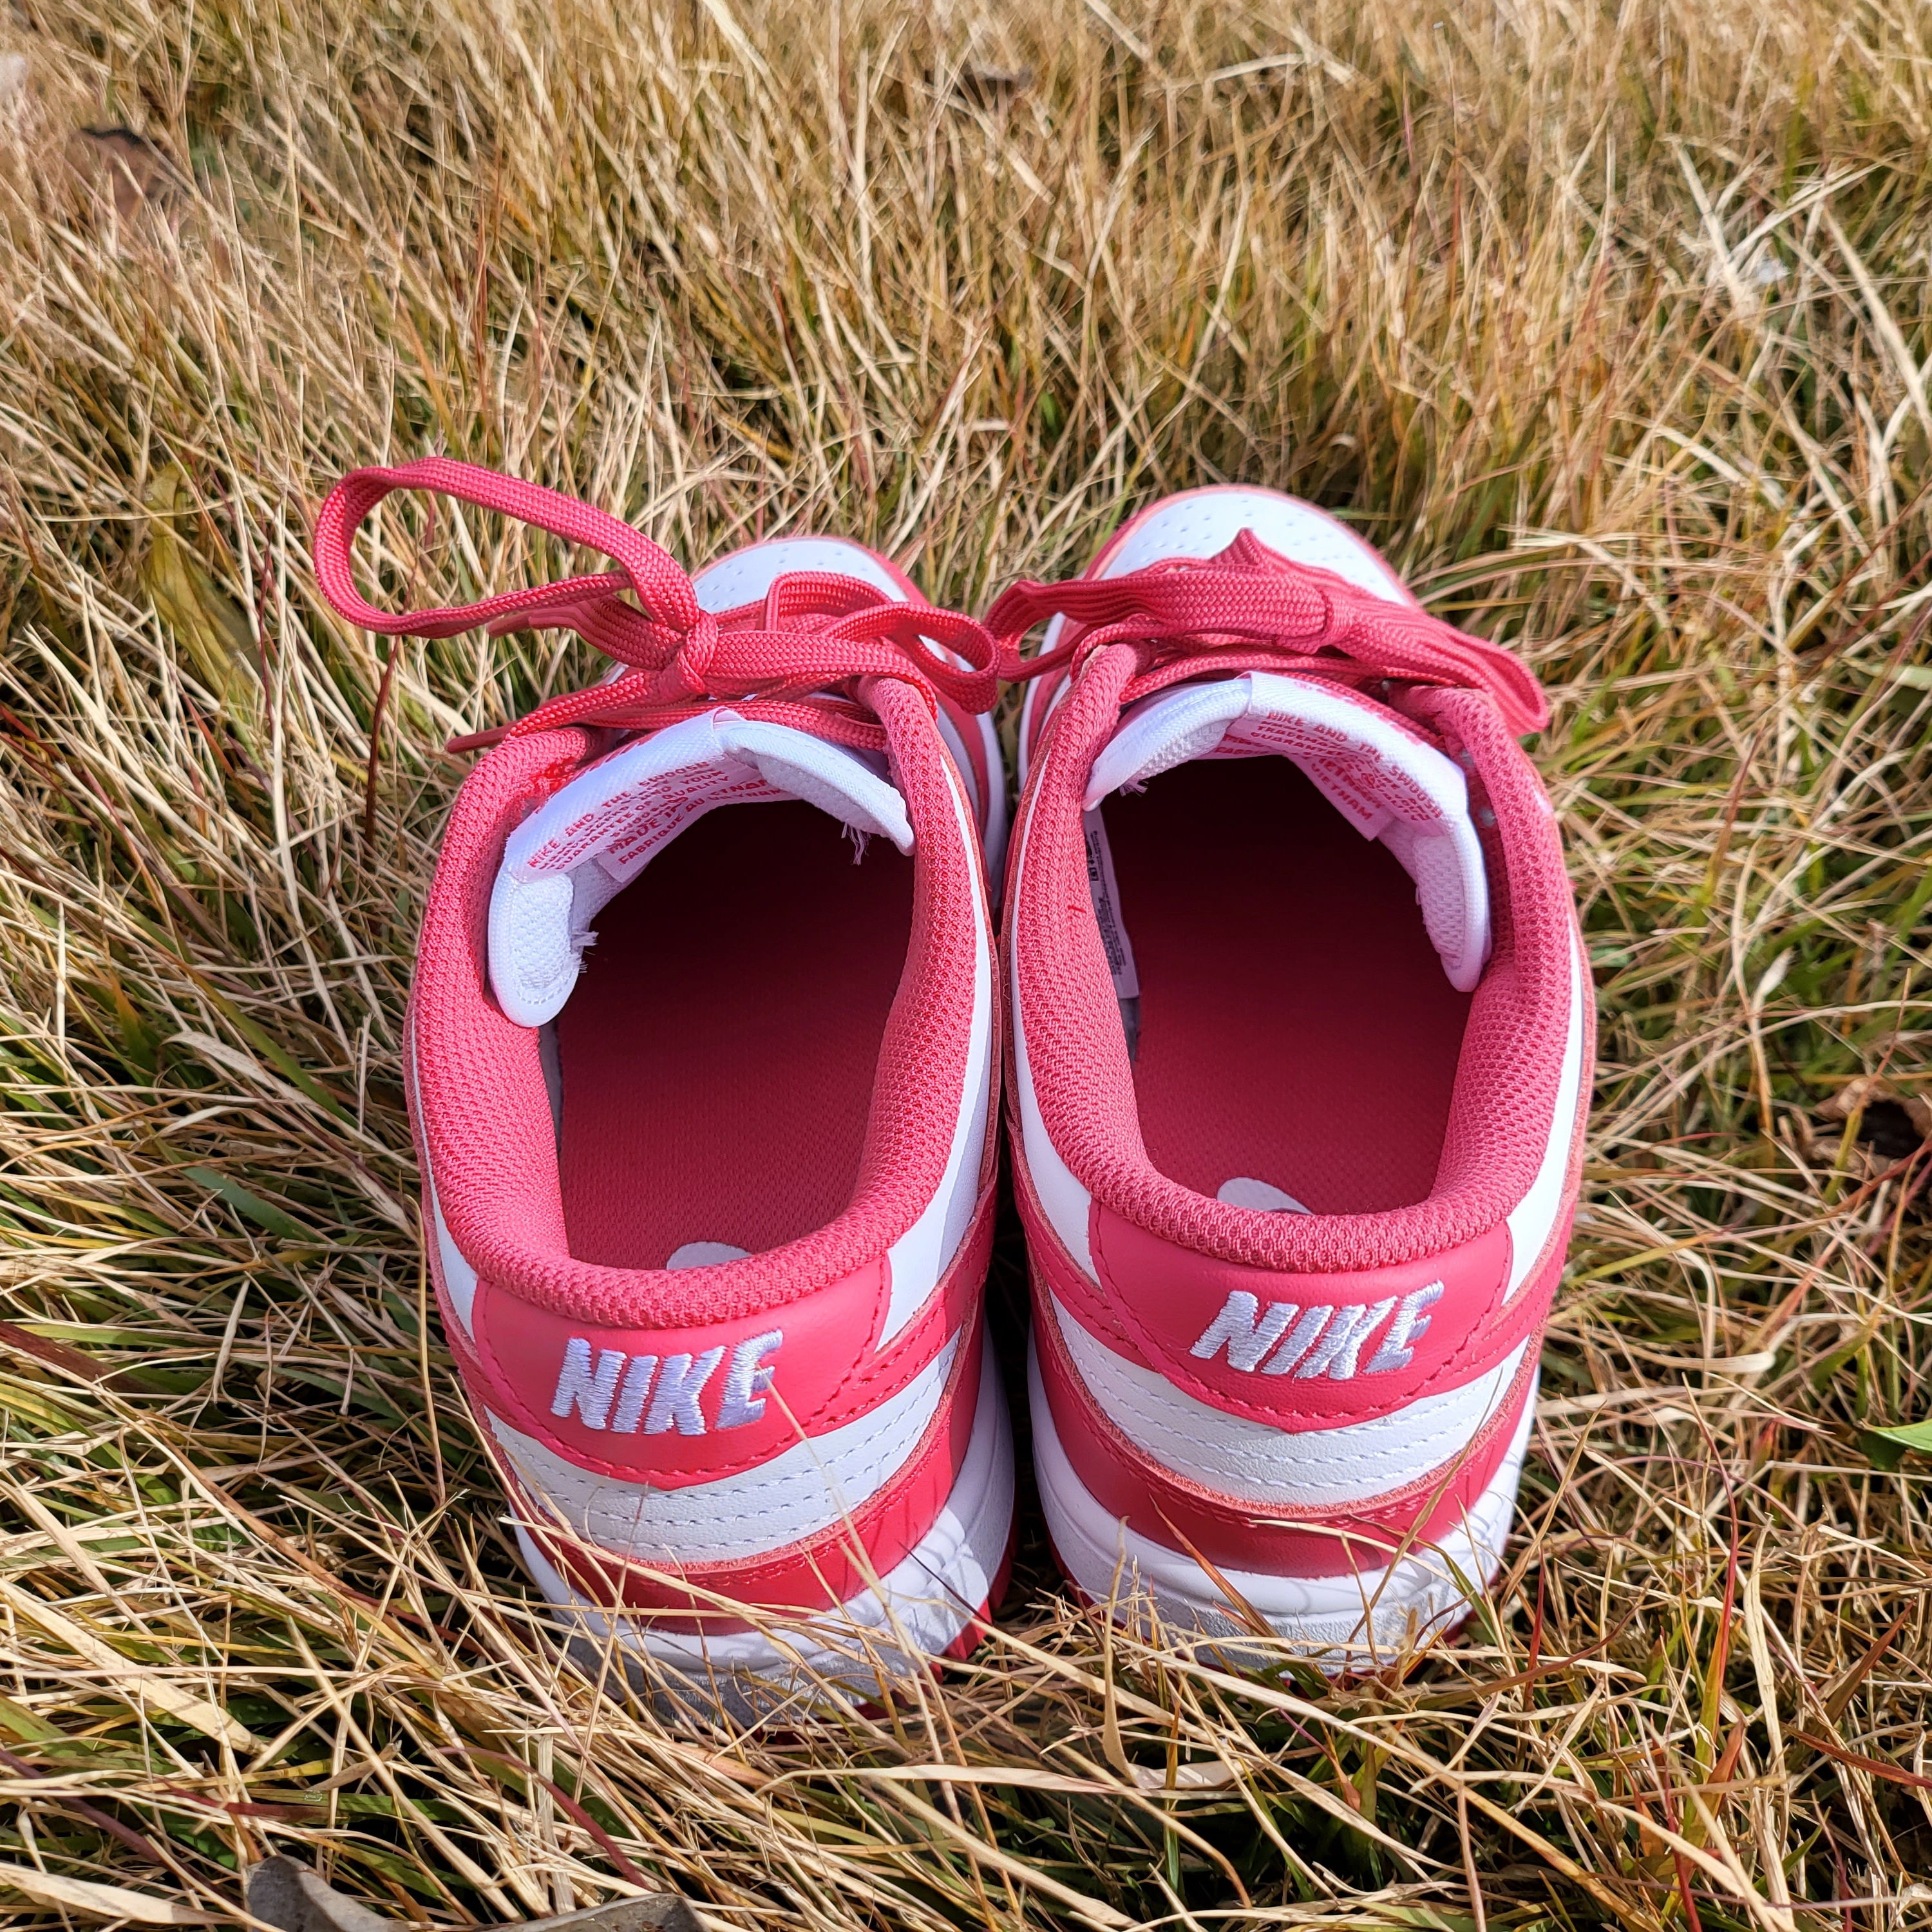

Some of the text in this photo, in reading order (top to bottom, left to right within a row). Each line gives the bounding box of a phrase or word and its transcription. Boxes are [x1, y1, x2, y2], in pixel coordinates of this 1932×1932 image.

[527, 839, 561, 868] NIKE
[565, 813, 594, 837] AND
[601, 791, 631, 808] THE
[638, 761, 709, 786] SWOOSH
[661, 775, 729, 800] QUALITY
[1267, 711, 1303, 727] NIKE
[1313, 723, 1348, 743] AND
[1388, 764, 1442, 819] SWOOSH
[618, 813, 685, 864] FABRIQUE
[685, 797, 706, 822] AU
[1189, 1279, 1444, 1379] NIKE
[550, 1328, 784, 1435] NIKE
